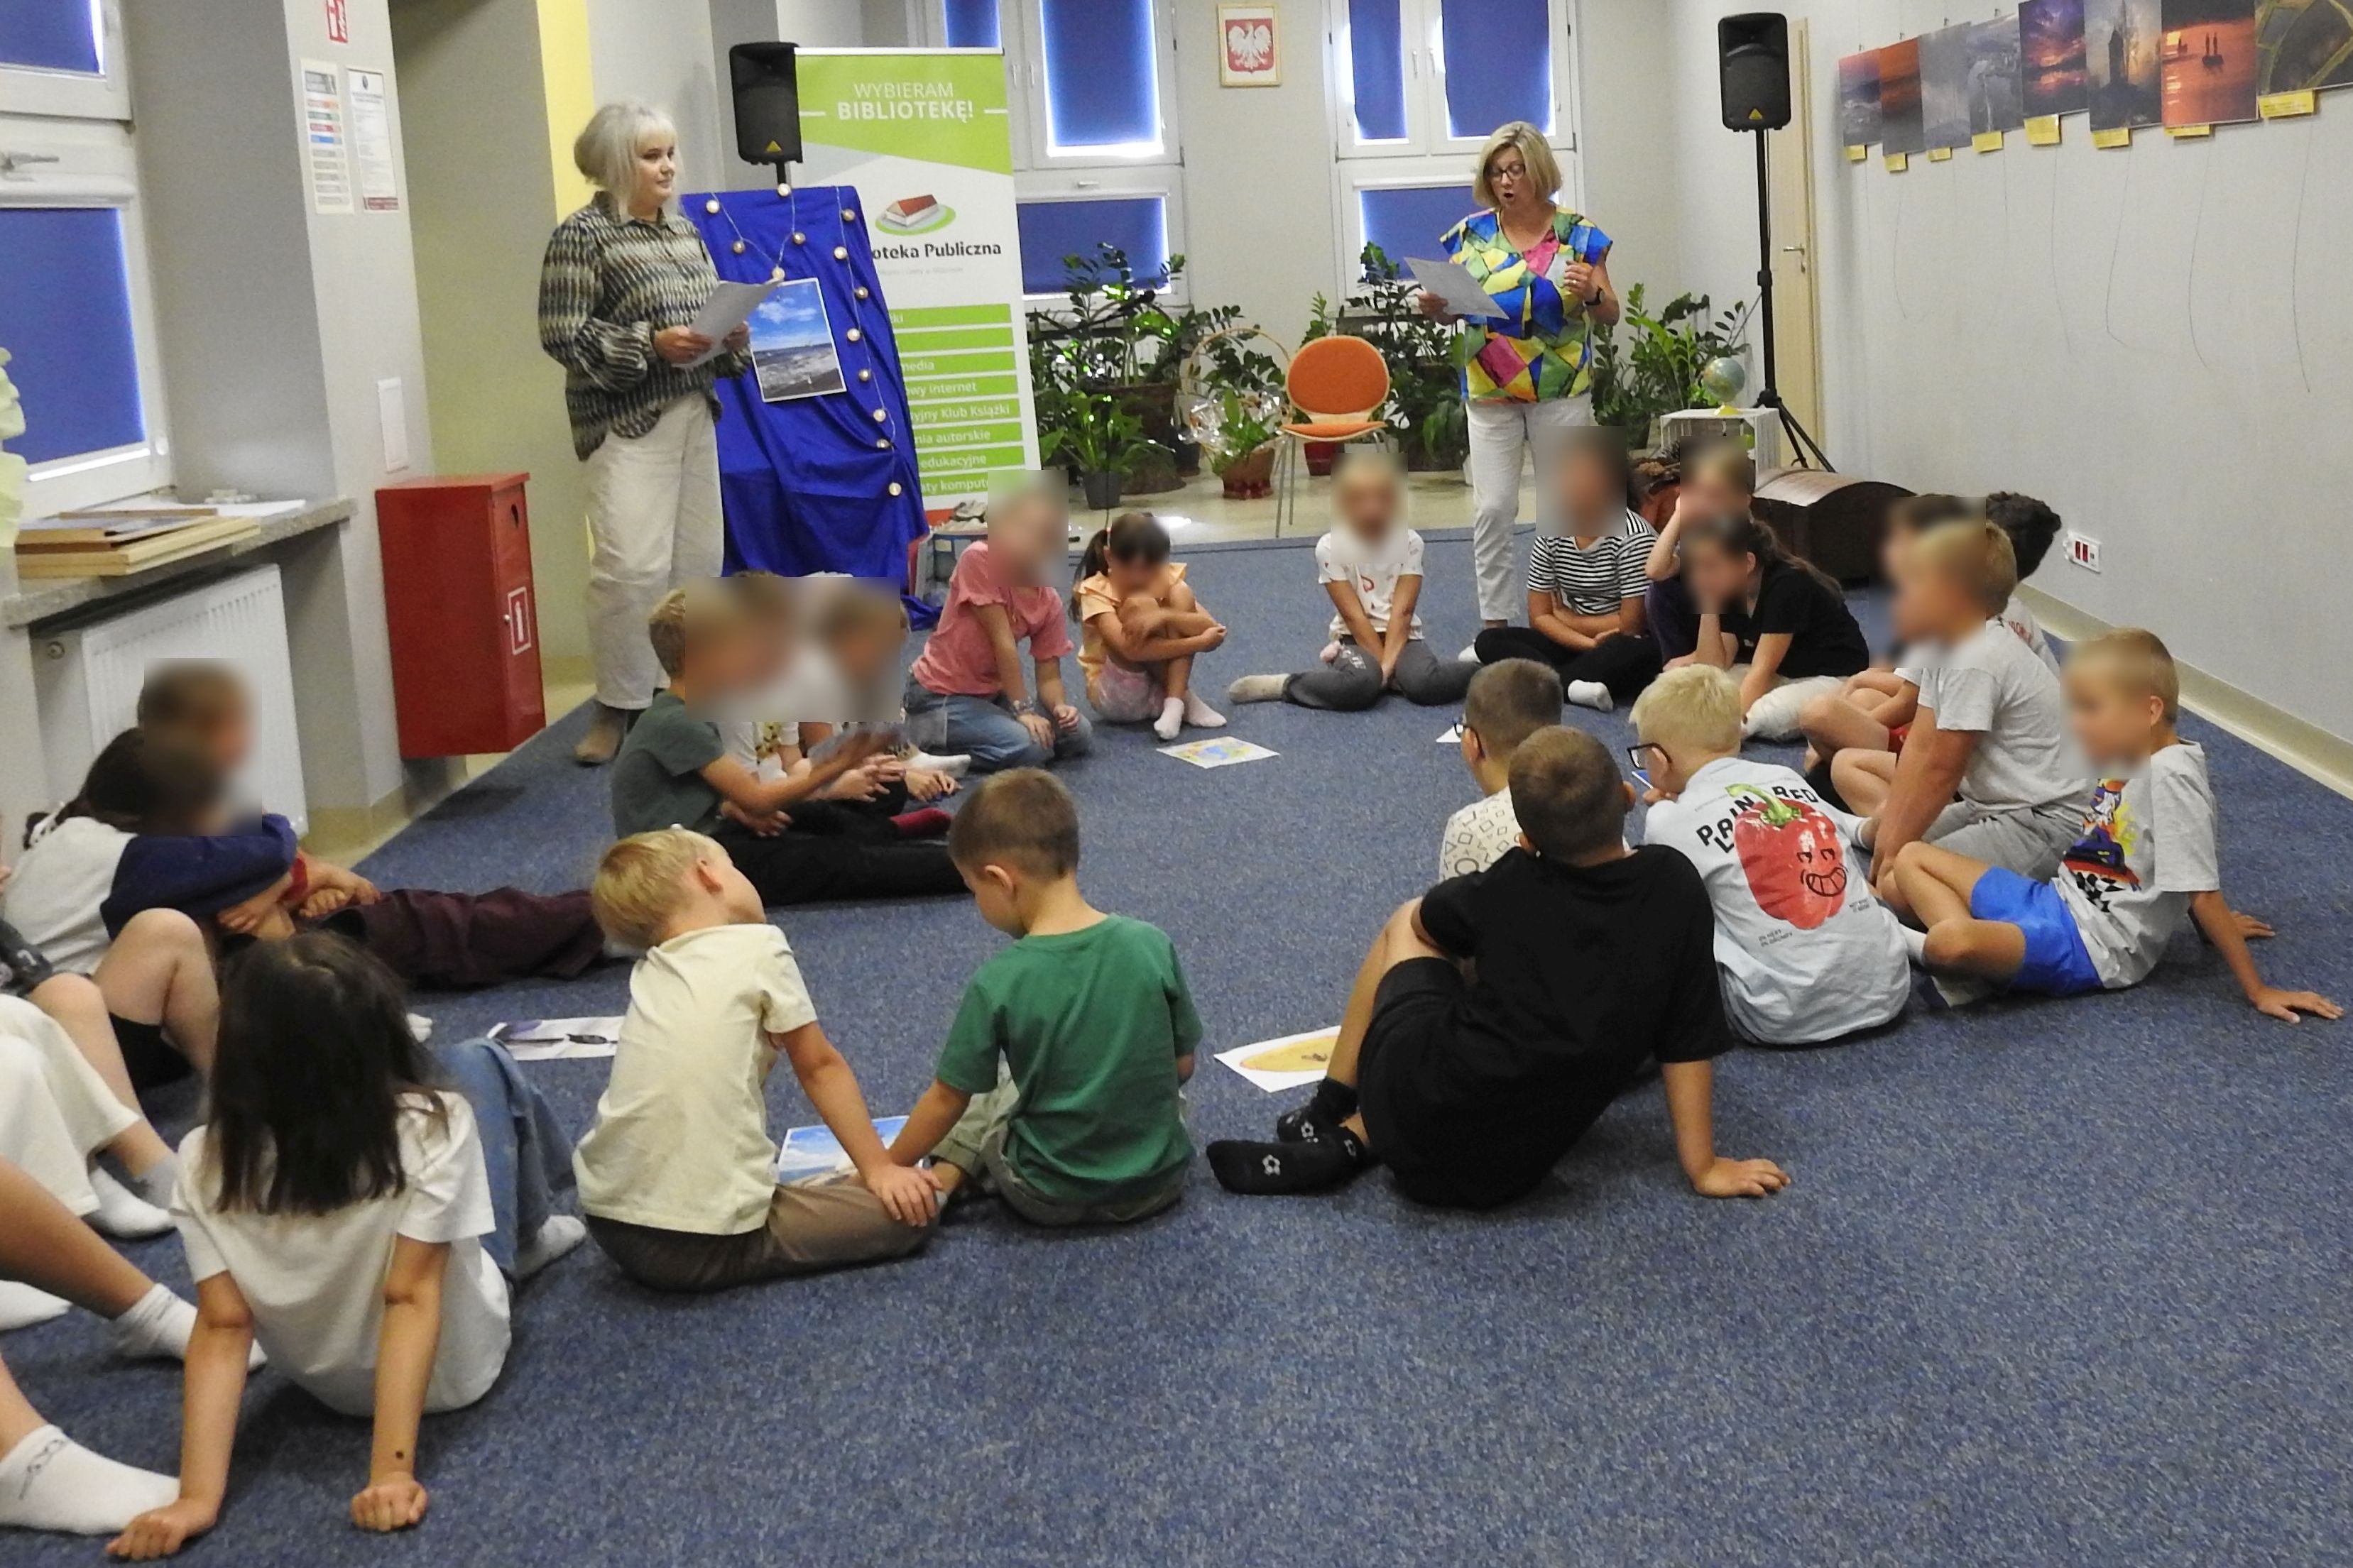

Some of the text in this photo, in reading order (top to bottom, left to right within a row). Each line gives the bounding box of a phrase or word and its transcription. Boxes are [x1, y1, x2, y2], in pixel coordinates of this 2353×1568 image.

[853, 82, 954, 99] WYBIERAM
[837, 100, 973, 124] BIBLIOTEKĘ!
[924, 241, 1002, 258] Publiczna
[929, 381, 978, 394] internet
[941, 405, 968, 418] Klub
[970, 403, 1010, 419] Książki
[936, 429, 990, 444] autorskie
[919, 454, 987, 470] edukacyjne
